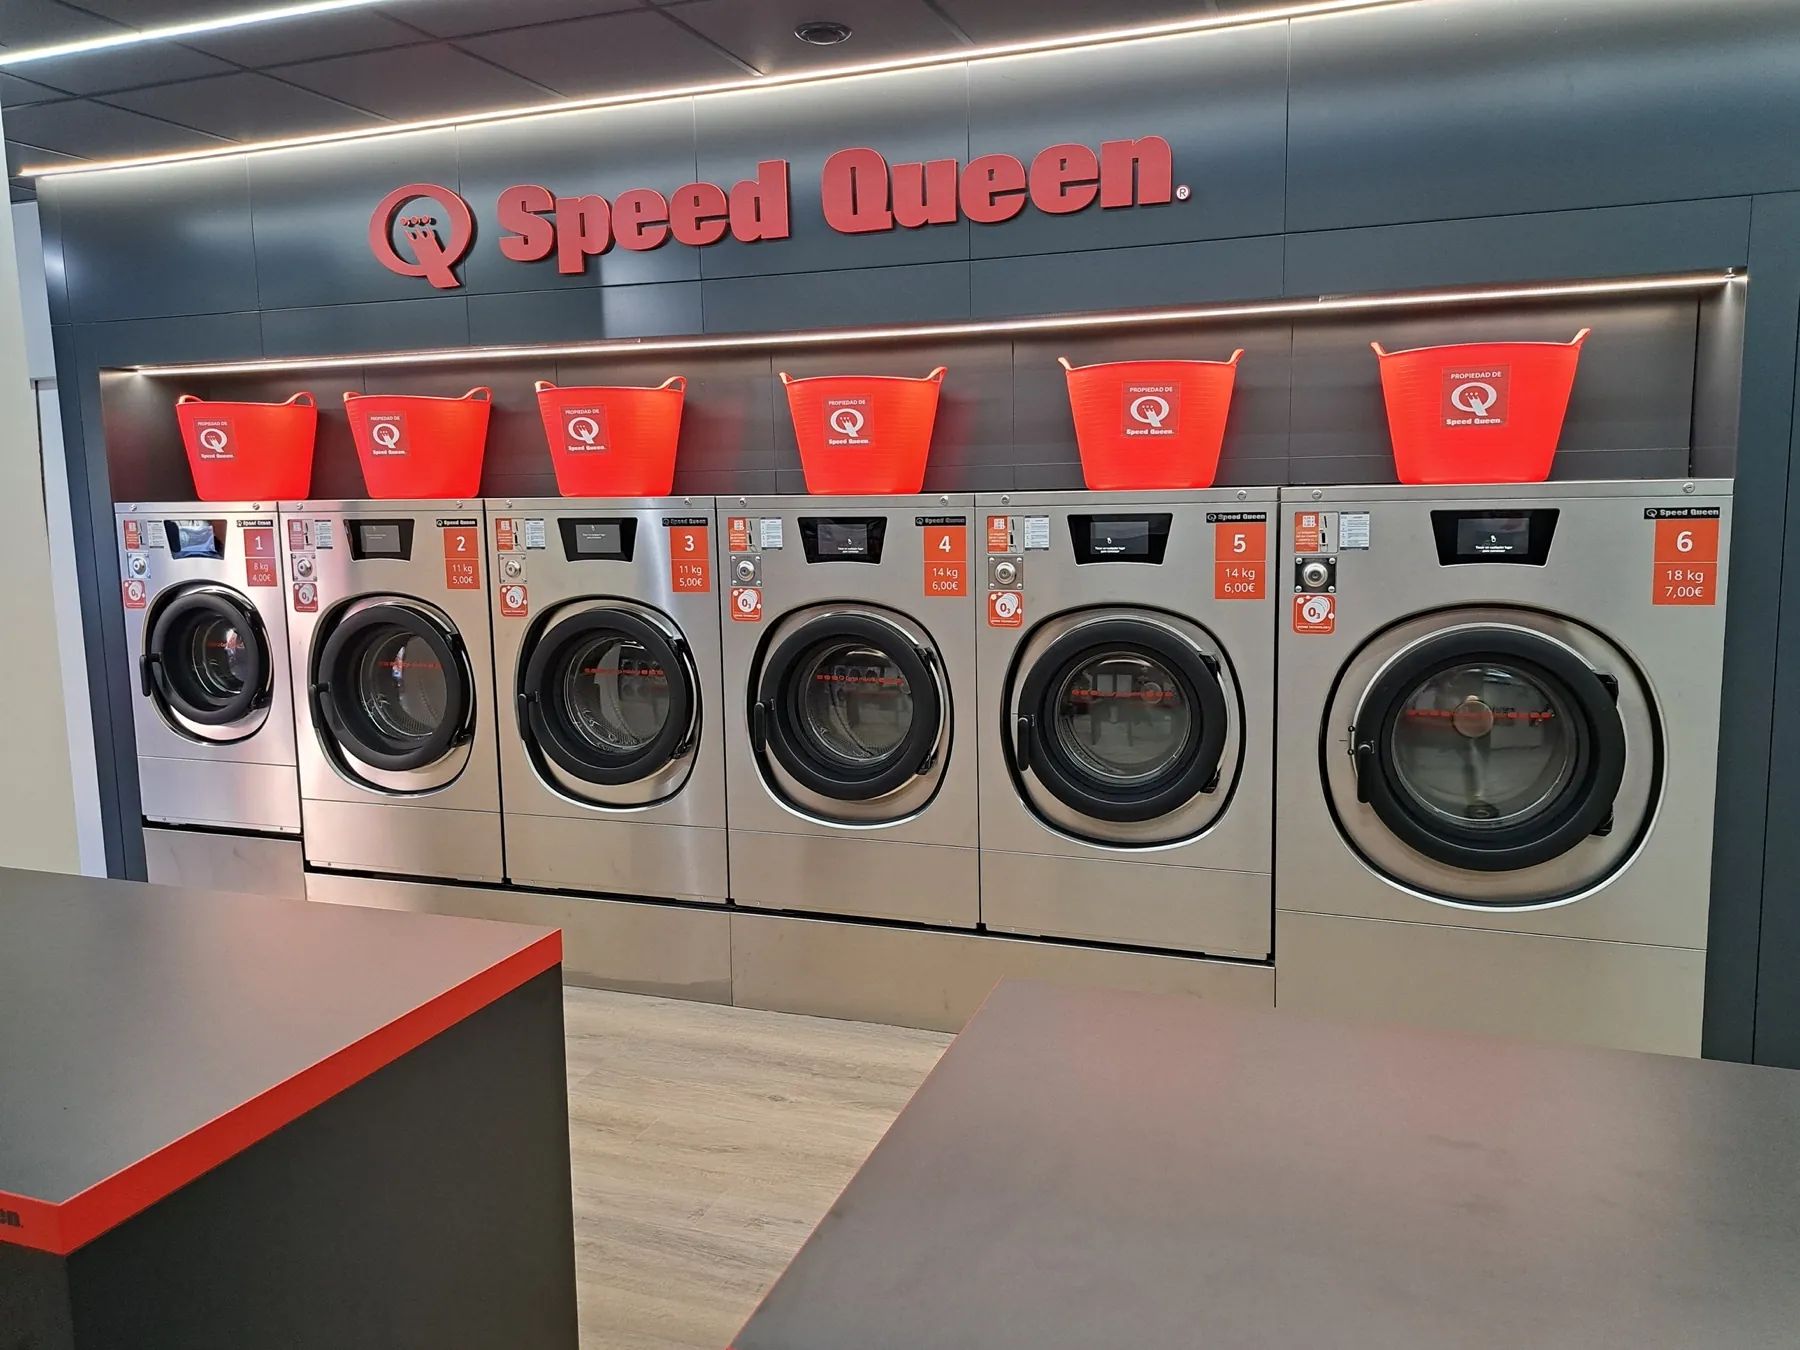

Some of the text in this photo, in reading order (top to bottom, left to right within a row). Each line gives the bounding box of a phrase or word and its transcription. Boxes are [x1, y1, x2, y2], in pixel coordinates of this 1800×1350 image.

[497, 159, 789, 274] Speed
[1450, 371, 1491, 380] PROPIEDAD
[1446, 418, 1472, 426] Speed
[1659, 509, 1688, 517] Speed
[255, 535, 264, 550] 1
[456, 536, 466, 552] 2
[684, 535, 695, 551] 3
[938, 535, 951, 553] 4
[1233, 534, 1246, 553] 5
[1676, 531, 1693, 552] 6
[260, 562, 269, 572] kg
[452, 563, 473, 574] 11 kg
[679, 564, 702, 576] 11 kg
[932, 567, 958, 579] 14 kg
[1225, 567, 1256, 580] 14 kg
[1666, 569, 1704, 584] 18 kg
[679, 577, 703, 587] 5,00€
[932, 581, 959, 591] 6,00€
[1224, 582, 1256, 593] 6,00€
[1664, 586, 1704, 598] 7,00€
